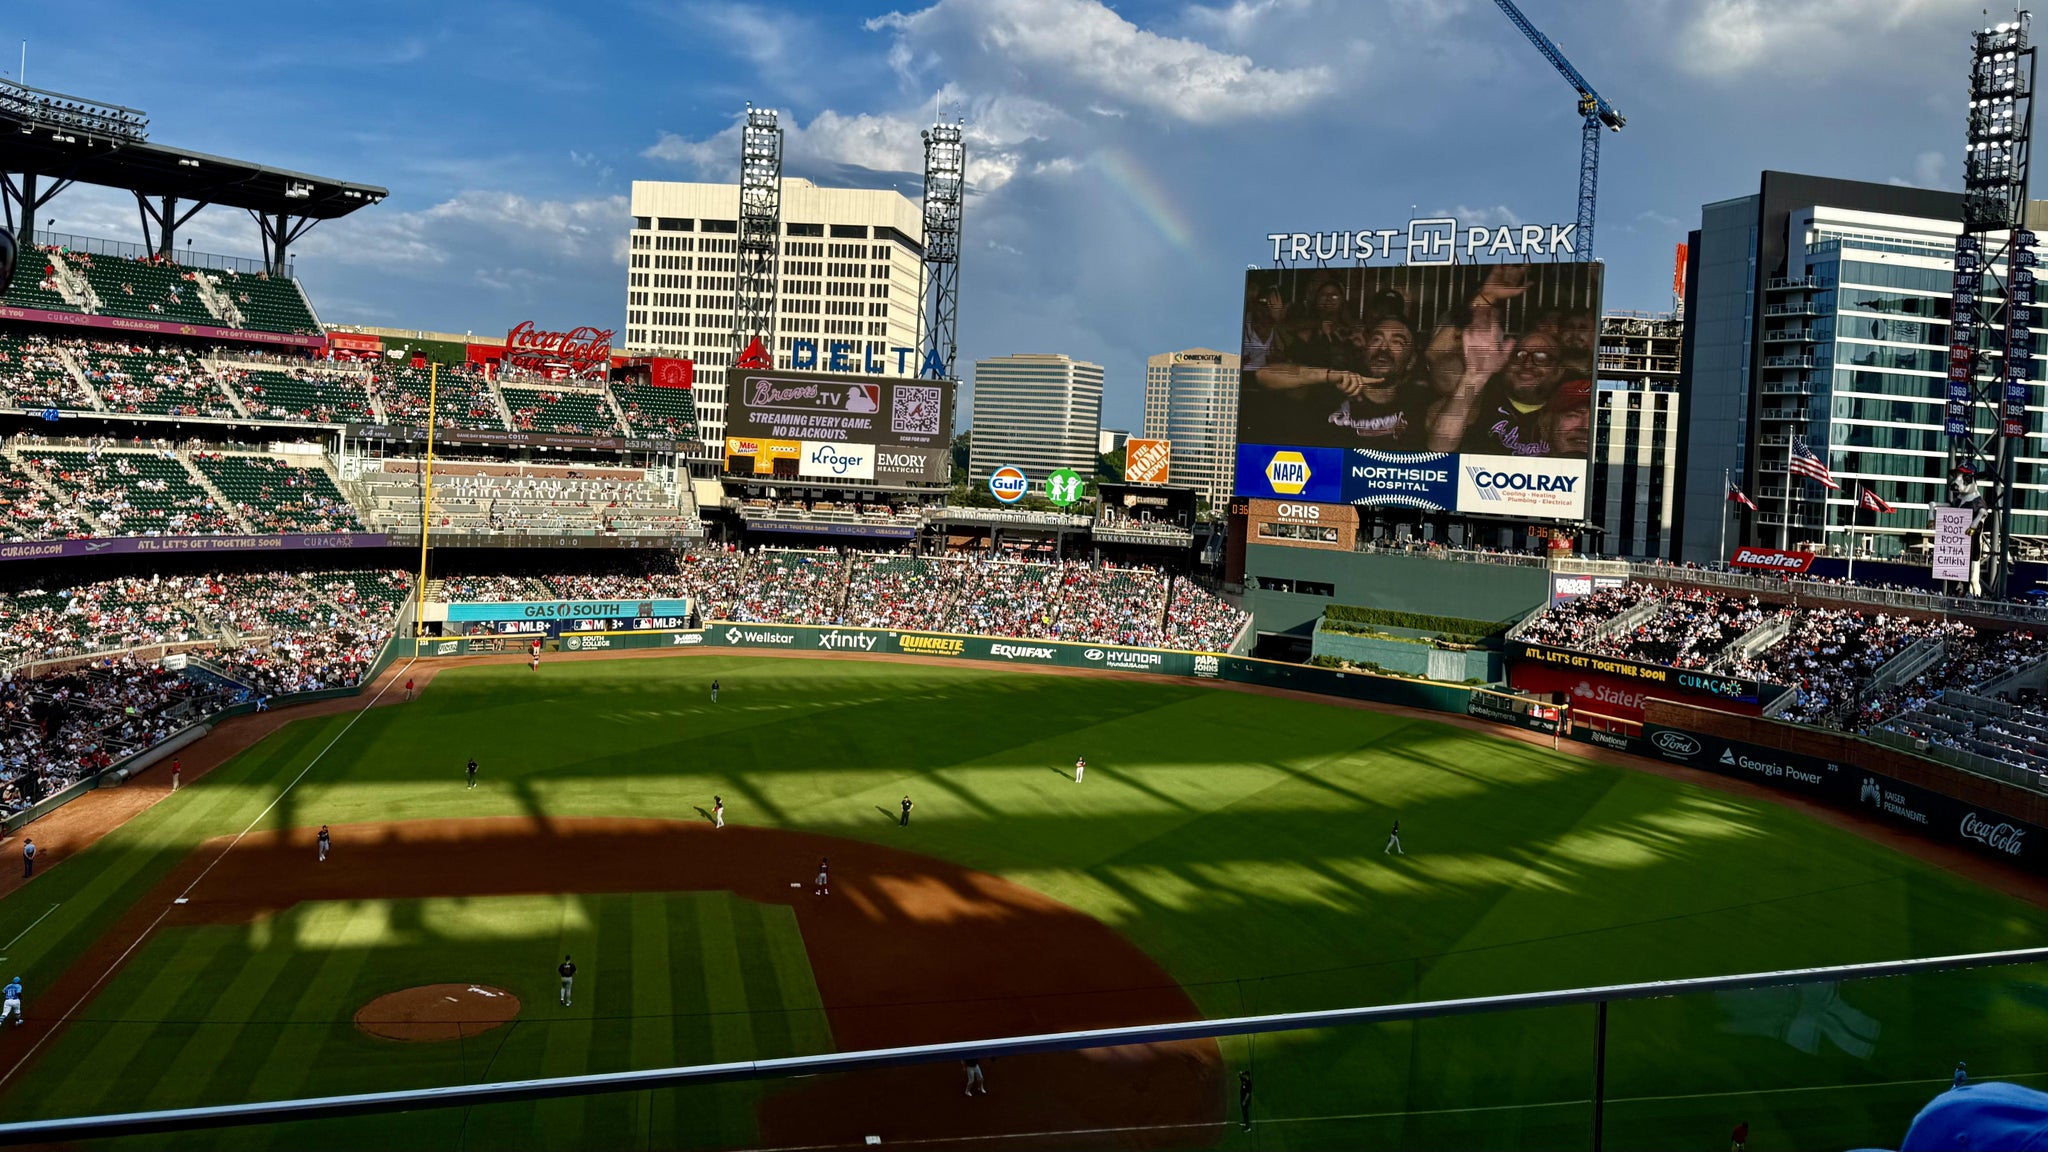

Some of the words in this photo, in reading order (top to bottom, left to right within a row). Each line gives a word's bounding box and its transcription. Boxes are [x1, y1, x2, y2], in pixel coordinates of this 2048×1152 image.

[1267, 229, 1399, 261] TRUIST
[1467, 223, 1578, 256] PARK
[1960, 239, 1974, 248] 1872
[2018, 234, 2033, 244] 1873
[1959, 257, 1973, 266] 1874
[2016, 253, 2032, 263] 1875
[1958, 275, 1972, 285] 1877
[2015, 272, 2031, 281] 1878
[1956, 294, 1972, 303] 1883
[2014, 291, 2029, 301] 1891
[1955, 312, 1971, 322] 1892
[2013, 310, 2029, 320] 1893
[245, 333, 281, 341] EVERYTHING
[1954, 330, 1969, 341] 1897
[2012, 329, 2028, 339] 1898
[1952, 349, 1968, 359] 1914
[2010, 348, 2027, 358] 1948
[792, 340, 946, 379] DELTA
[1951, 368, 1967, 377] 1957
[2009, 367, 2026, 377] 1958
[752, 379, 817, 405] Braves
[1950, 386, 1966, 396] 1969
[2008, 386, 2024, 396] 1982
[1949, 404, 1964, 414] 1991
[2007, 404, 2024, 416] 1992
[749, 412, 807, 425] STREAMING
[810, 416, 840, 428] EVERY
[841, 417, 872, 429] GAME.
[359, 429, 373, 437] 6.4
[772, 427, 788, 437] NO
[789, 427, 848, 440] BLACKOUTS.
[1948, 423, 1964, 433] 1993
[2005, 424, 2022, 434] 1995
[641, 441, 652, 449] PM
[1131, 444, 1149, 460] THE
[812, 445, 863, 474] Kroger
[877, 453, 927, 467] EMORY
[1127, 440, 1169, 481] HOME
[877, 466, 925, 474] HEALTHCARE
[1142, 456, 1169, 482] DEPOT
[1273, 463, 1303, 482] NAPA
[1352, 466, 1448, 483] NORTHSIDE
[992, 478, 1024, 490] Gulf
[1368, 480, 1430, 492] HOSPITAL
[1475, 471, 1579, 492] COOLRAY
[451, 477, 501, 498] HANK
[505, 479, 569, 500] AARON
[571, 481, 653, 502] TERRACE
[1502, 490, 1526, 498] Cooling
[1278, 503, 1320, 519] ORIS
[1943, 515, 1964, 524] ROOT
[1528, 526, 1548, 538] 0:36
[1943, 525, 1963, 534] ROOT
[138, 540, 160, 550] ATL,
[163, 539, 188, 549] LET'S
[191, 539, 207, 548] GET
[211, 539, 256, 547] TOGETHER
[258, 538, 281, 547] SOON
[1941, 535, 1964, 545] ROOT
[1, 544, 62, 557] CURAÇAO.COM
[1940, 546, 1945, 554] 4
[1949, 547, 1964, 555] THA
[1737, 550, 1803, 568] RaceTrac
[1937, 556, 1966, 566] CHIKIN
[524, 606, 554, 617] GAS
[573, 604, 620, 615] SOUTH
[519, 621, 551, 632] MLB+
[653, 617, 682, 628] MLB+
[744, 631, 794, 644] Wellstar
[819, 630, 877, 651] xfinity
[899, 635, 964, 650] QUIKRETE
[990, 643, 1053, 659] EQUIFAX
[1107, 651, 1161, 665] HYUNDAI
[1195, 656, 1218, 665] PAPA
[1194, 664, 1219, 672] JOHNS
[1526, 647, 1544, 660] ATL,
[1547, 651, 1570, 664] LET'S
[1572, 656, 1588, 668] GET
[1593, 659, 1638, 676] TOGETHER
[1640, 668, 1666, 681] SOON
[1600, 734, 1627, 747] National
[1660, 733, 1692, 753] Ford
[1739, 756, 1782, 776] Georgia
[1786, 766, 1822, 784] Power
[1884, 790, 1906, 805] KAISER
[1884, 801, 1927, 823] PERMANENTE
[1960, 812, 2026, 856] Coca-Cola
